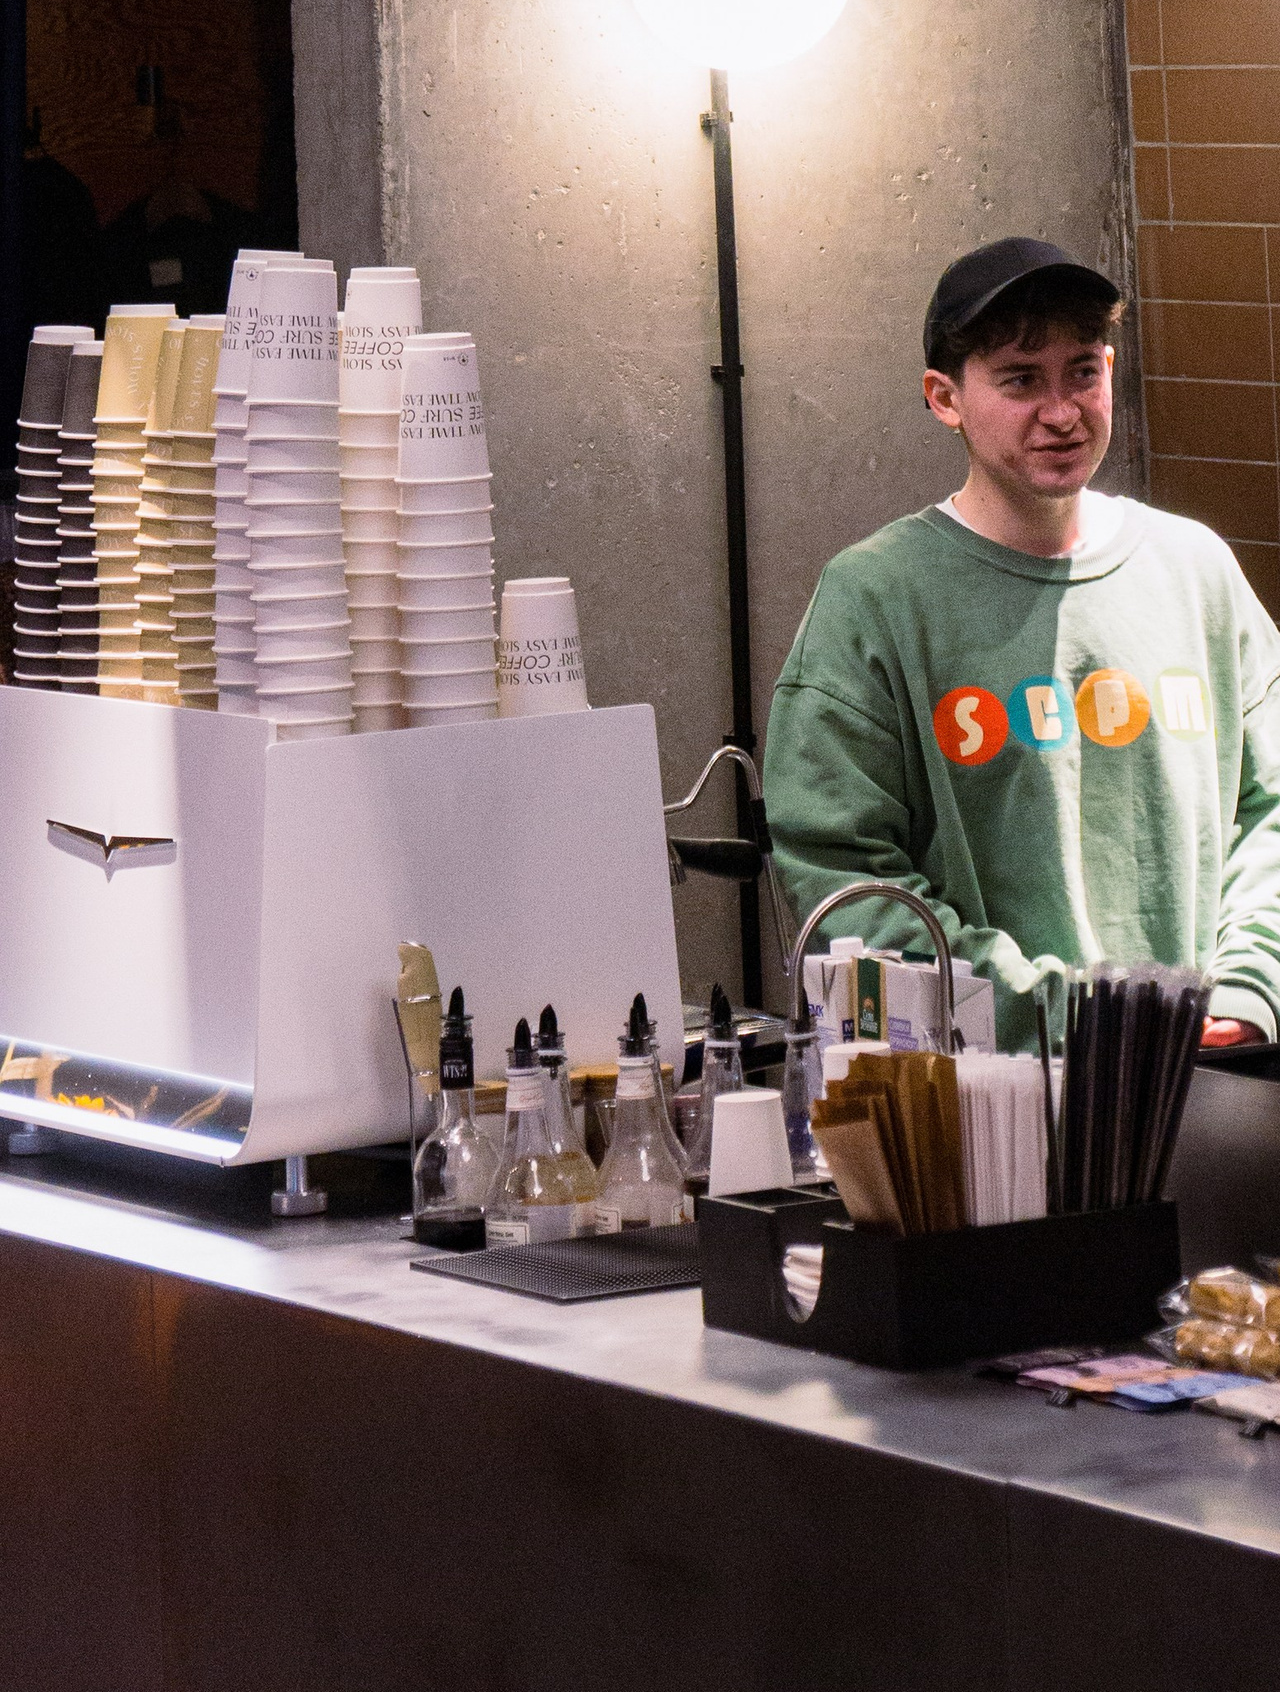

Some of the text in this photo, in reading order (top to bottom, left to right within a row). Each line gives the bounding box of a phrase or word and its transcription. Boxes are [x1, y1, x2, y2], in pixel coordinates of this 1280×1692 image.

[288, 315, 322, 328] TIME
[280, 329, 324, 345] SURF
[286, 348, 322, 361] TIME
[343, 340, 405, 356] COFFEE
[430, 393, 461, 406] TIME
[420, 409, 464, 425] SURF
[428, 426, 466, 439] TIME
[522, 638, 558, 653] EASY
[523, 670, 562, 685] EASY
